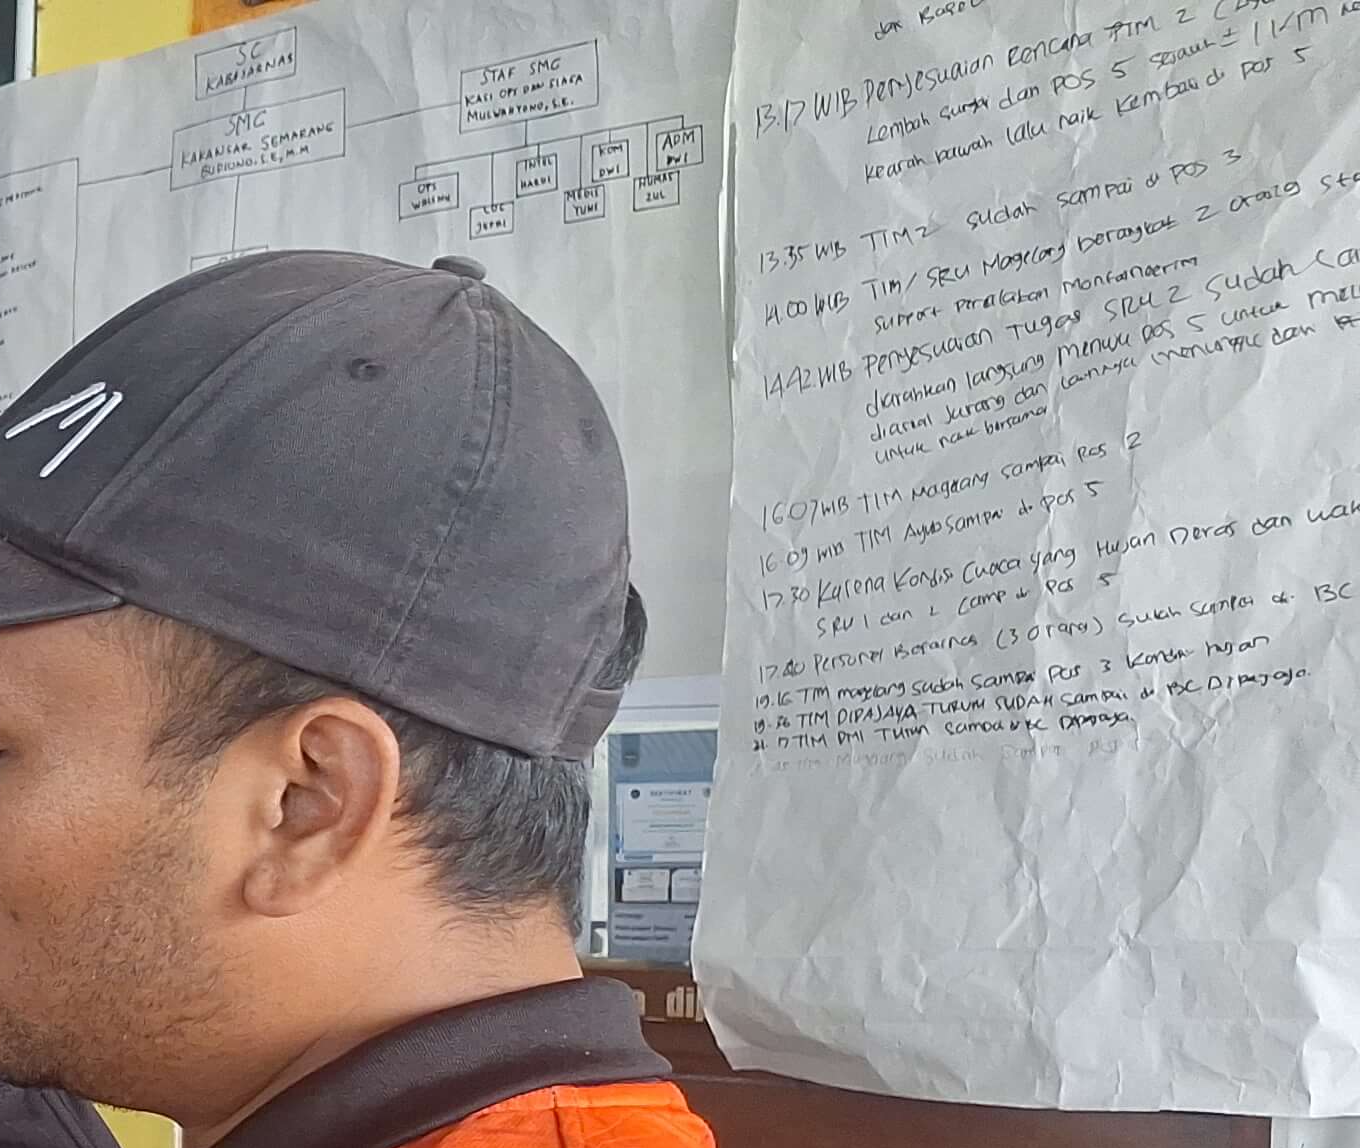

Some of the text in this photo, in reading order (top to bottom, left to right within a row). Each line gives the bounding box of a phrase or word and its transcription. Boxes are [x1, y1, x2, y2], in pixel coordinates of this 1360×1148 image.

[1295, 46, 1312, 64] 5
[1112, 56, 1136, 79] 5
[814, 87, 858, 121] WIB
[815, 240, 847, 261] WIB
[860, 228, 914, 251] TIM
[1223, 149, 1242, 166] 3
[815, 290, 850, 317] WIB
[1169, 285, 1191, 304] 2
[1187, 313, 1207, 332] 5
[858, 488, 903, 515] TIM
[1126, 431, 1142, 450] 2
[854, 525, 892, 552] TIM
[1085, 481, 1104, 497] 5
[1098, 572, 1119, 587] 5
[1314, 582, 1354, 602] BC
[796, 708, 829, 730] TIM
